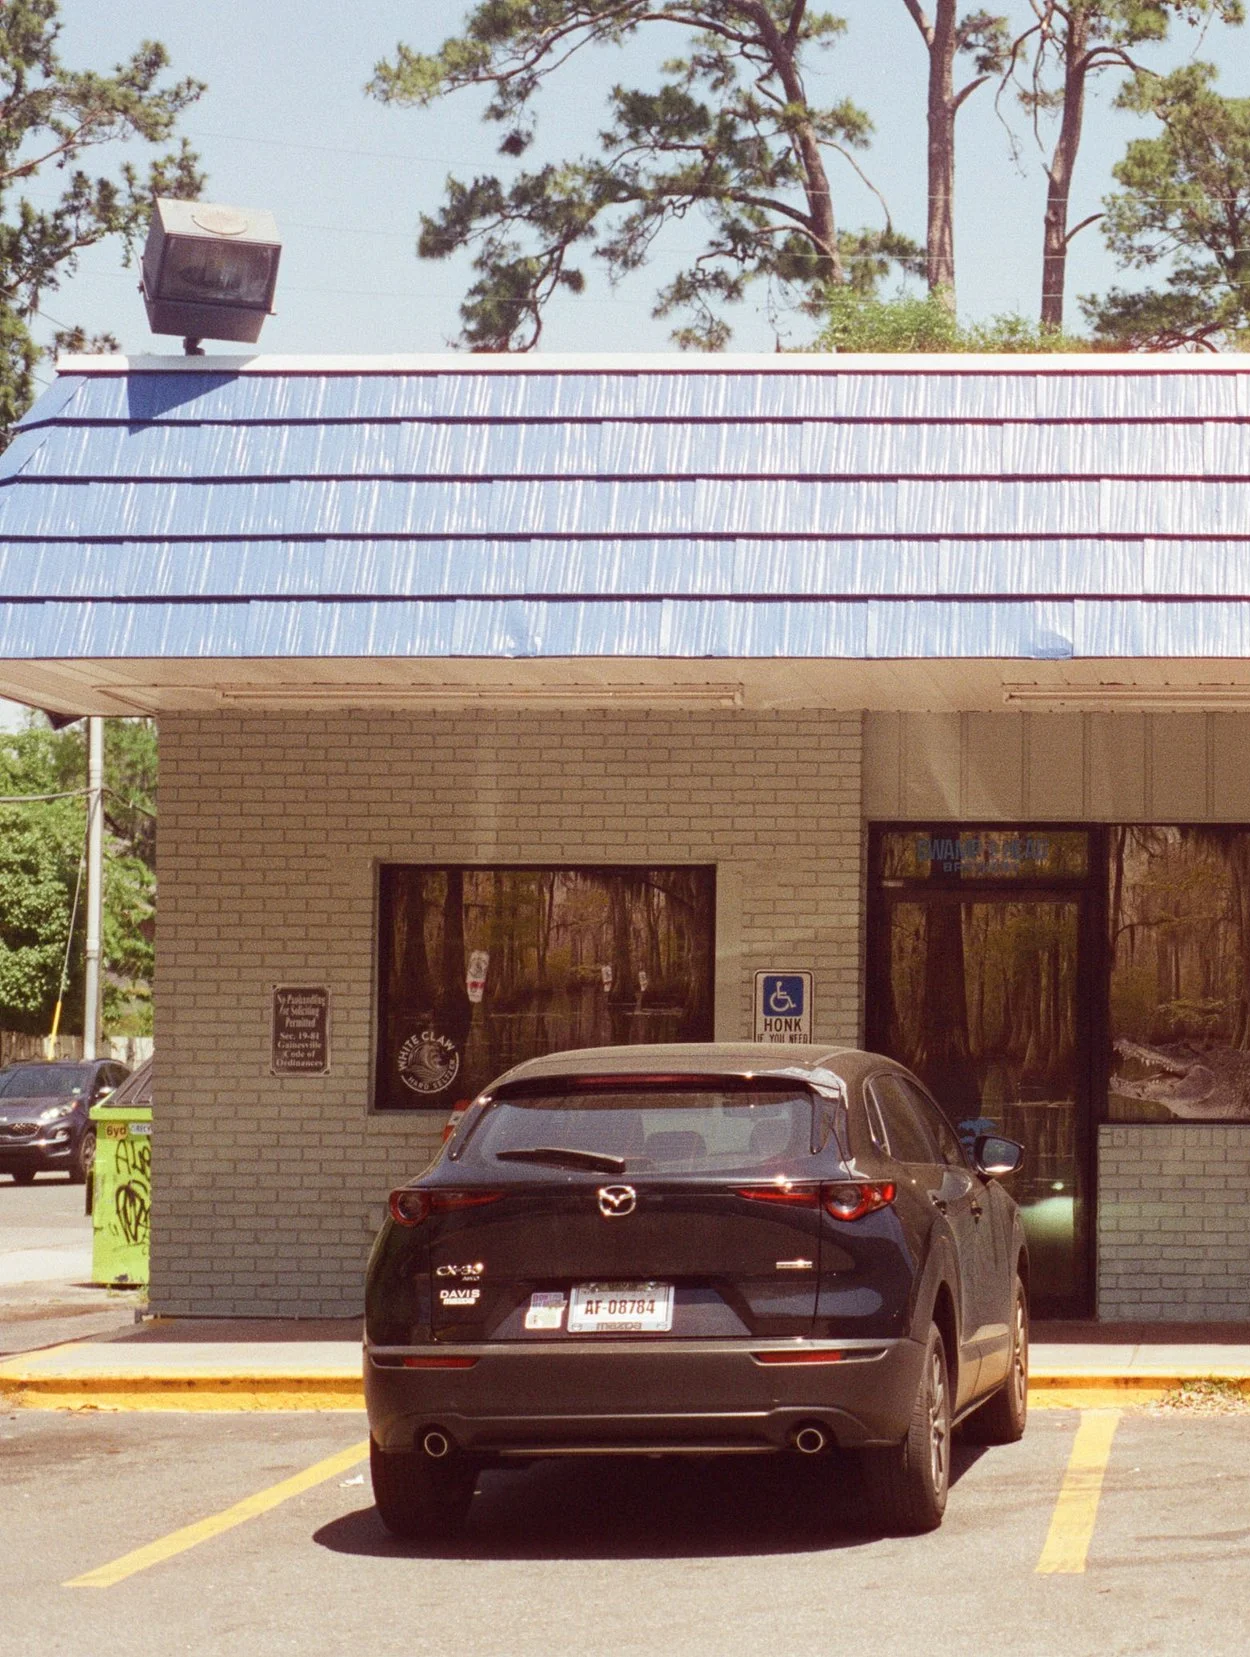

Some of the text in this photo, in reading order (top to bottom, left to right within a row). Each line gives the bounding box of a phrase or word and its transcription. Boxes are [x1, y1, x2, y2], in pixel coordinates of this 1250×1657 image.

[764, 1018, 802, 1032] HONK
[398, 1031, 456, 1071] WHITE CLAW
[106, 1125, 127, 1138] 6yd
[440, 1289, 480, 1298] DAVIS
[585, 1299, 655, 1315] AF-08784
[596, 1322, 642, 1330] mazda
